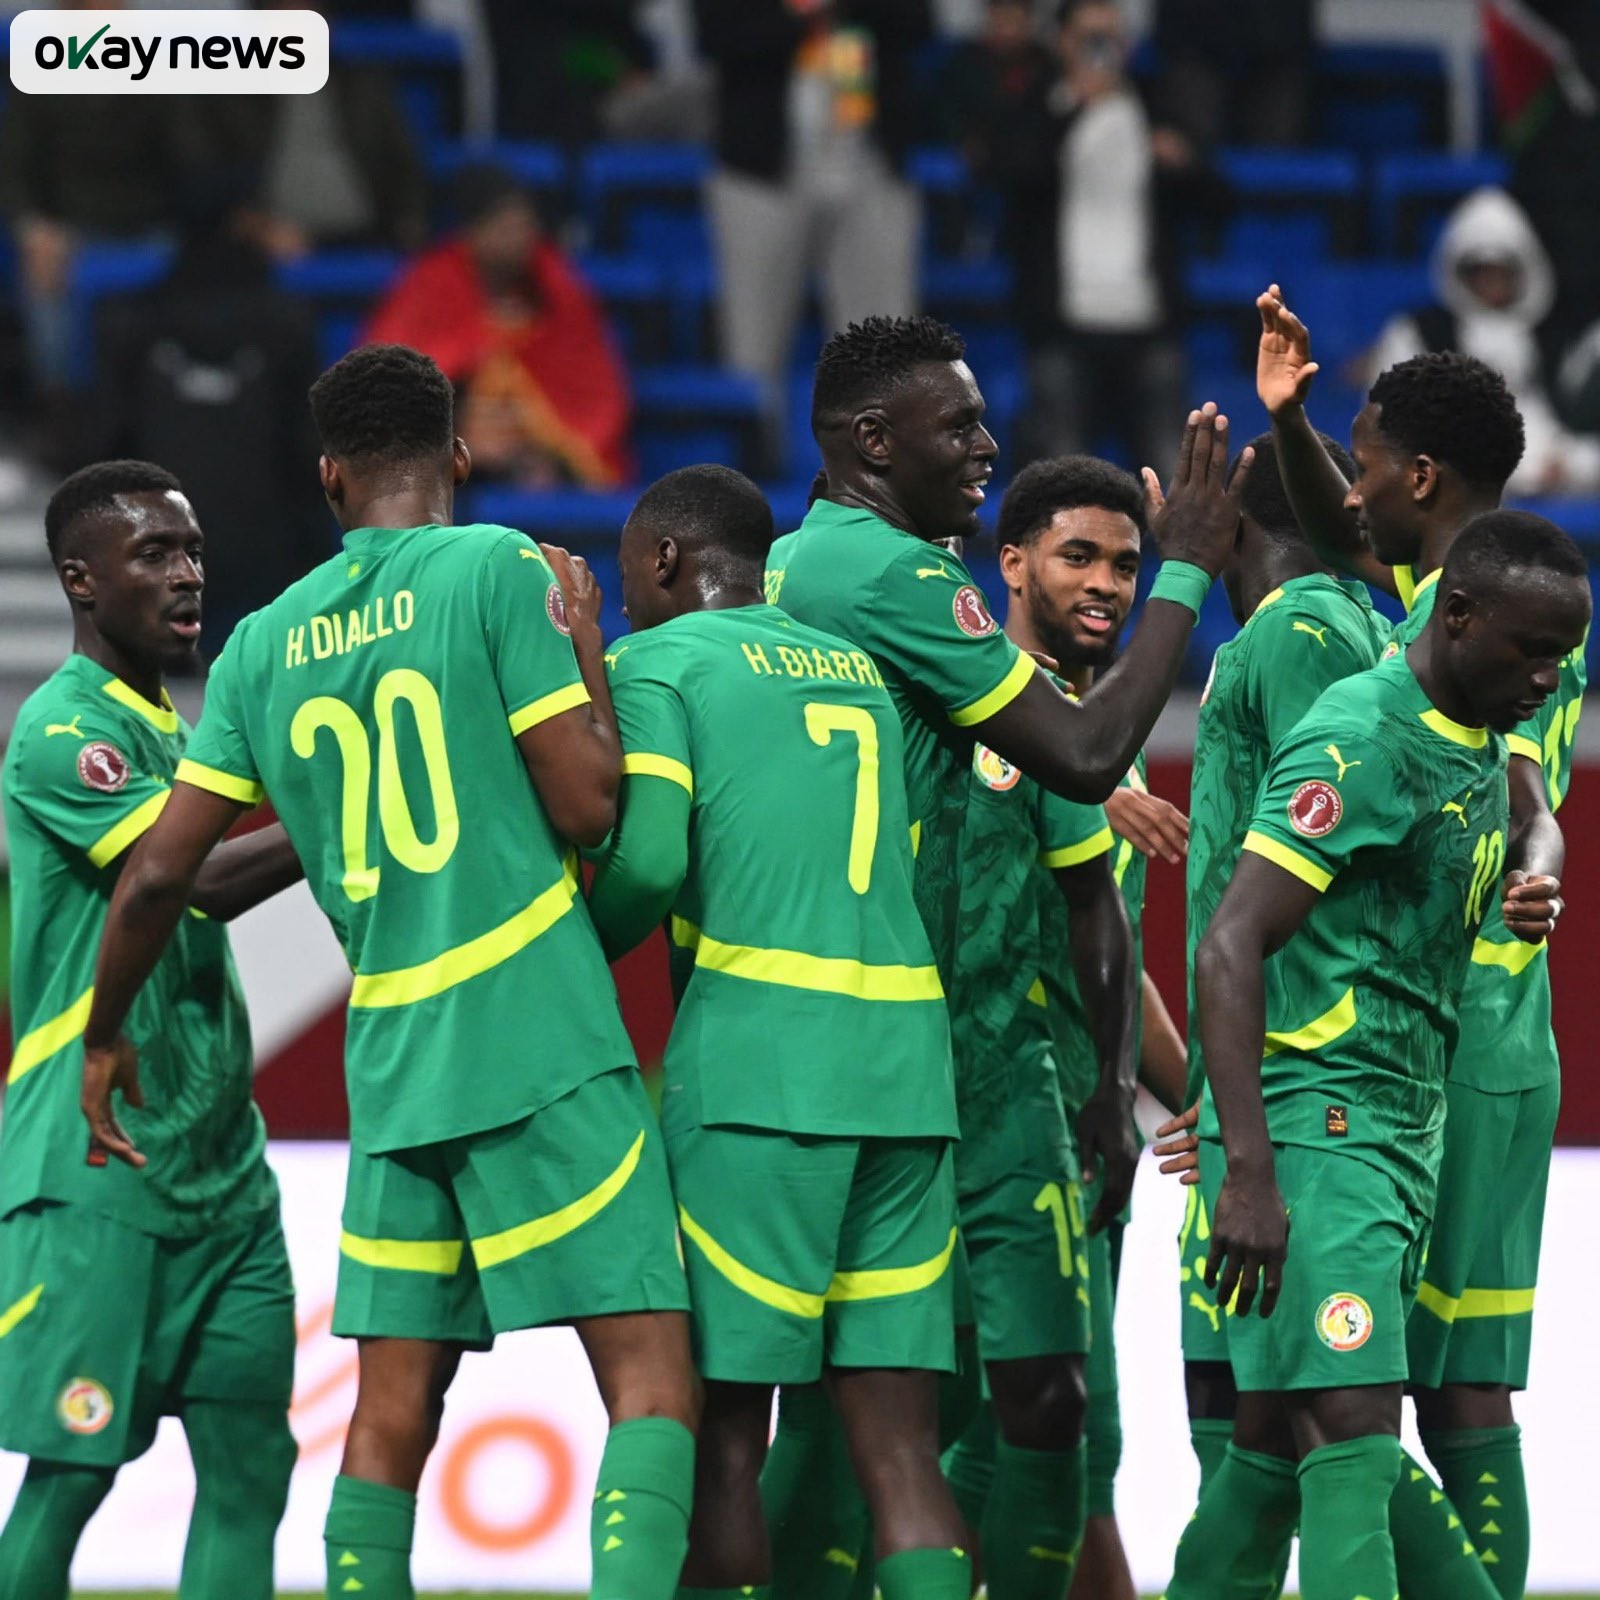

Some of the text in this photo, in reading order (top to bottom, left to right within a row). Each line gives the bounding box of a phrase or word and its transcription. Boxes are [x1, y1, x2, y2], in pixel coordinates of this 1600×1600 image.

[286, 590, 415, 669] H.DIALLO
[290, 668, 460, 903] 20
[804, 702, 880, 895] 7
